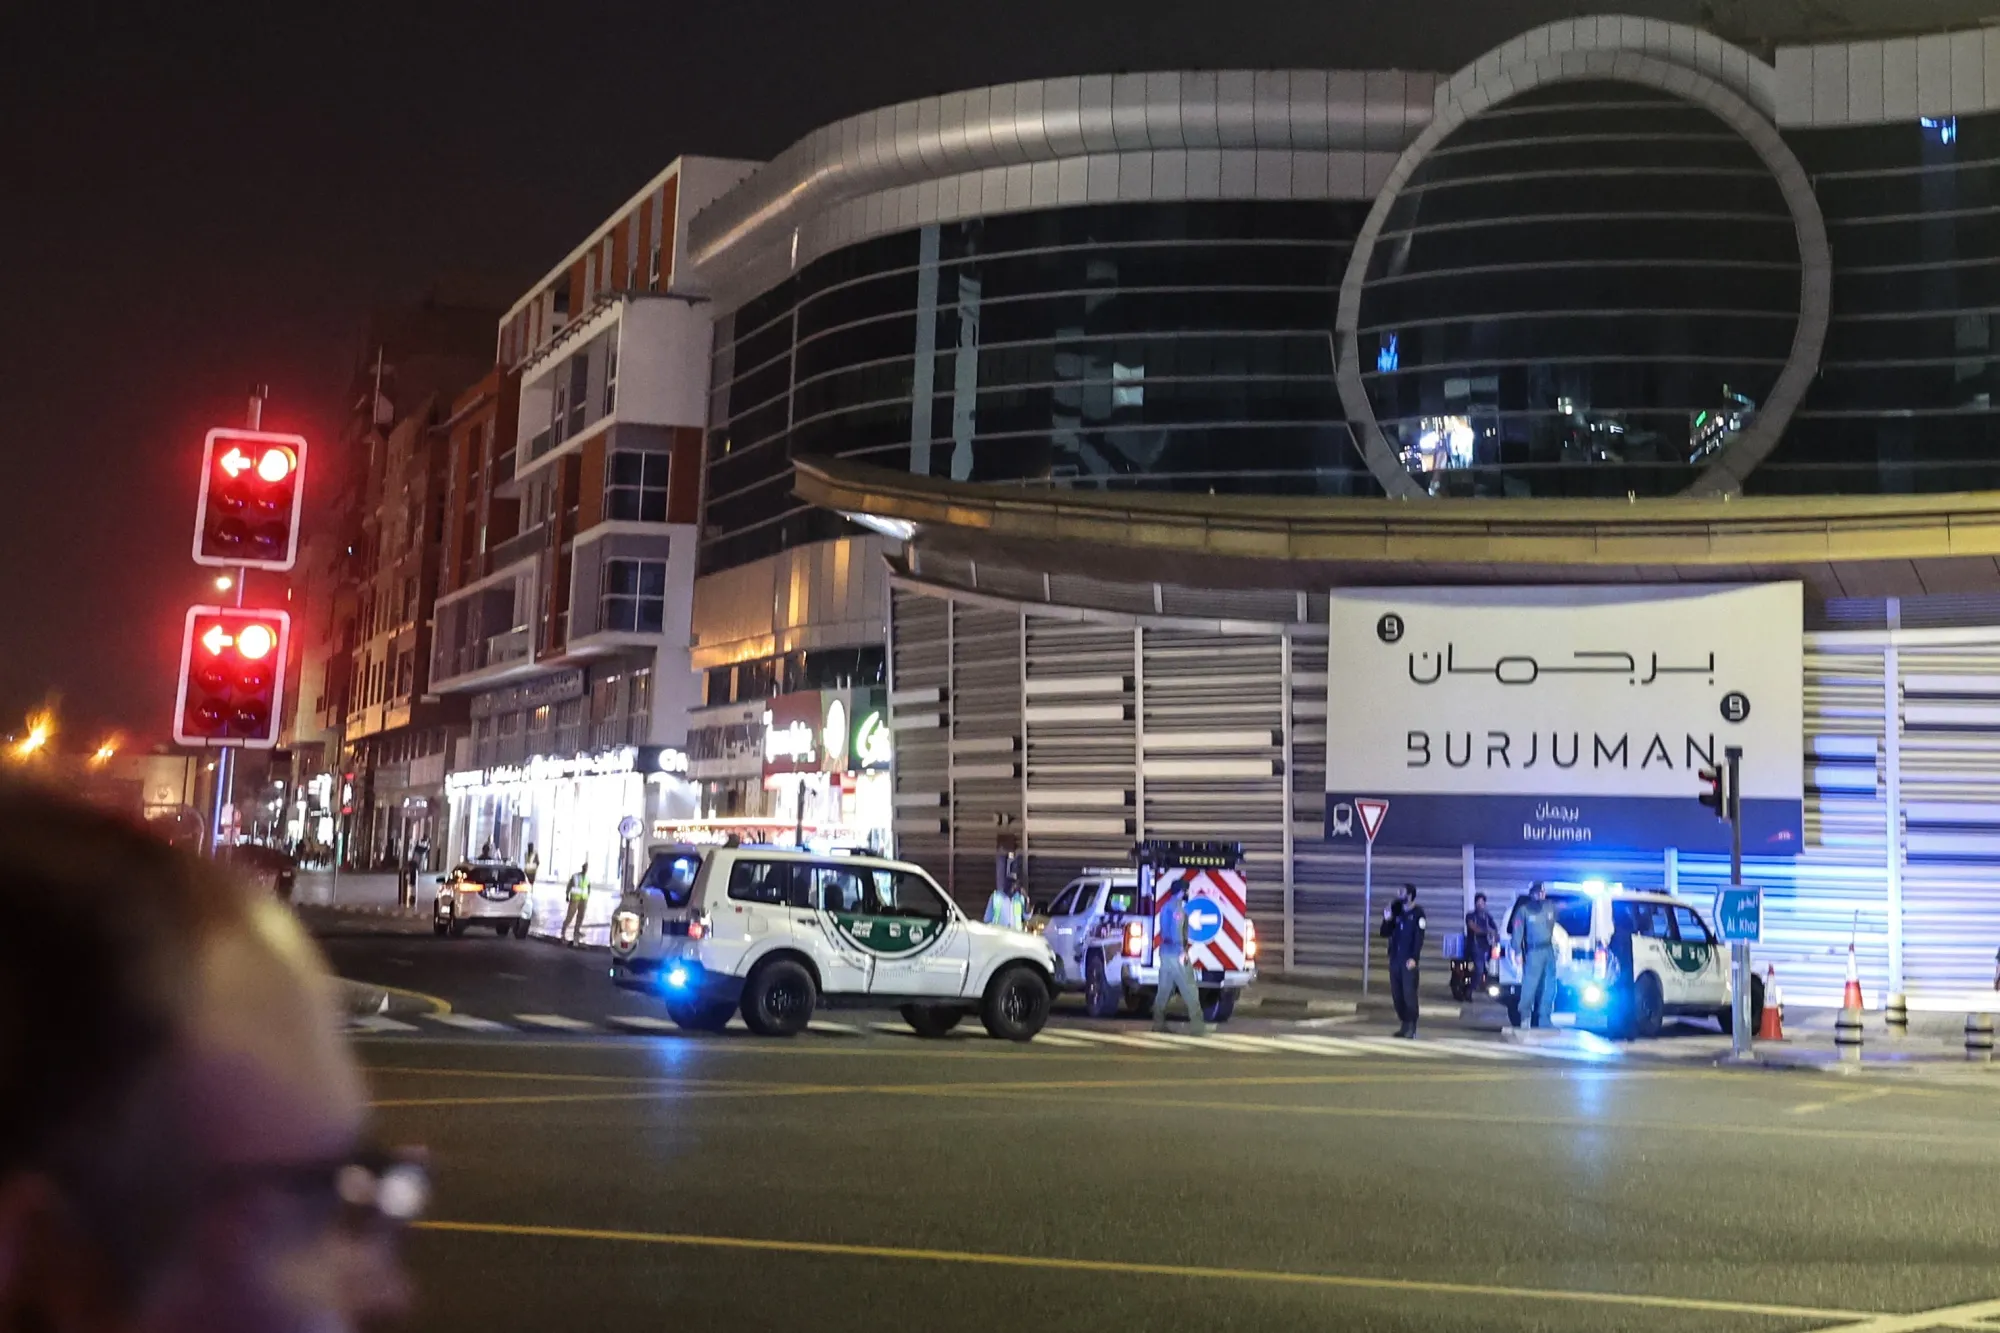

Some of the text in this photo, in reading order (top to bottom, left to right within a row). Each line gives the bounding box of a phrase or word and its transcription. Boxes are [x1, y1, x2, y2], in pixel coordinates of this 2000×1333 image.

[1408, 642, 1714, 685] برجمان
[1407, 731, 1715, 769] BURJUMAN
[1536, 801, 1580, 823] برجمان
[1523, 823, 1592, 842] BurJuman
